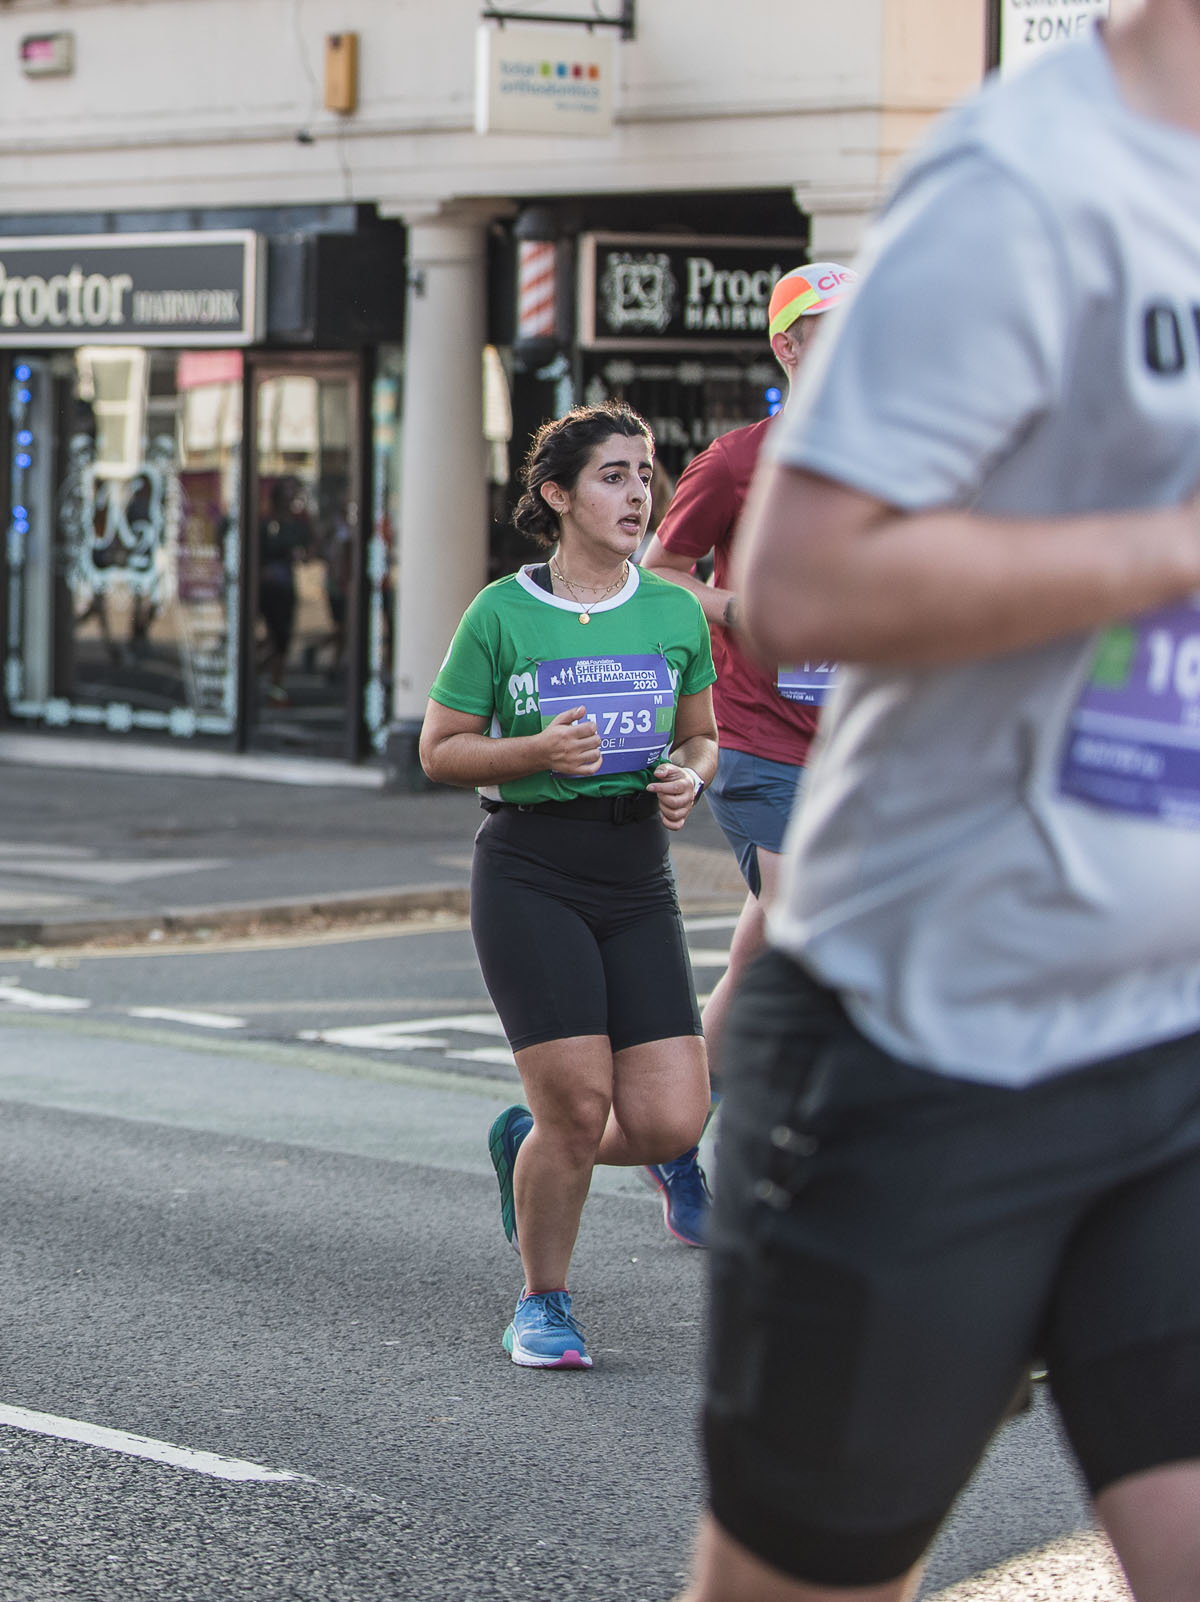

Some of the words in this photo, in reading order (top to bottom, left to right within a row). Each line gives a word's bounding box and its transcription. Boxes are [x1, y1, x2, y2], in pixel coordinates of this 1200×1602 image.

[687, 257, 784, 303] Proct
[817, 269, 853, 291] cie
[685, 304, 770, 330] HAIRW
[576, 664, 621, 674] SHEFFIELD
[1147, 628, 1200, 698] 10
[577, 674, 601, 683] HALF
[603, 671, 655, 682] MARATHON
[633, 680, 658, 690] 2020
[654, 695, 663, 705] M
[572, 709, 652, 736] 1753
[598, 738, 616, 749] OE
